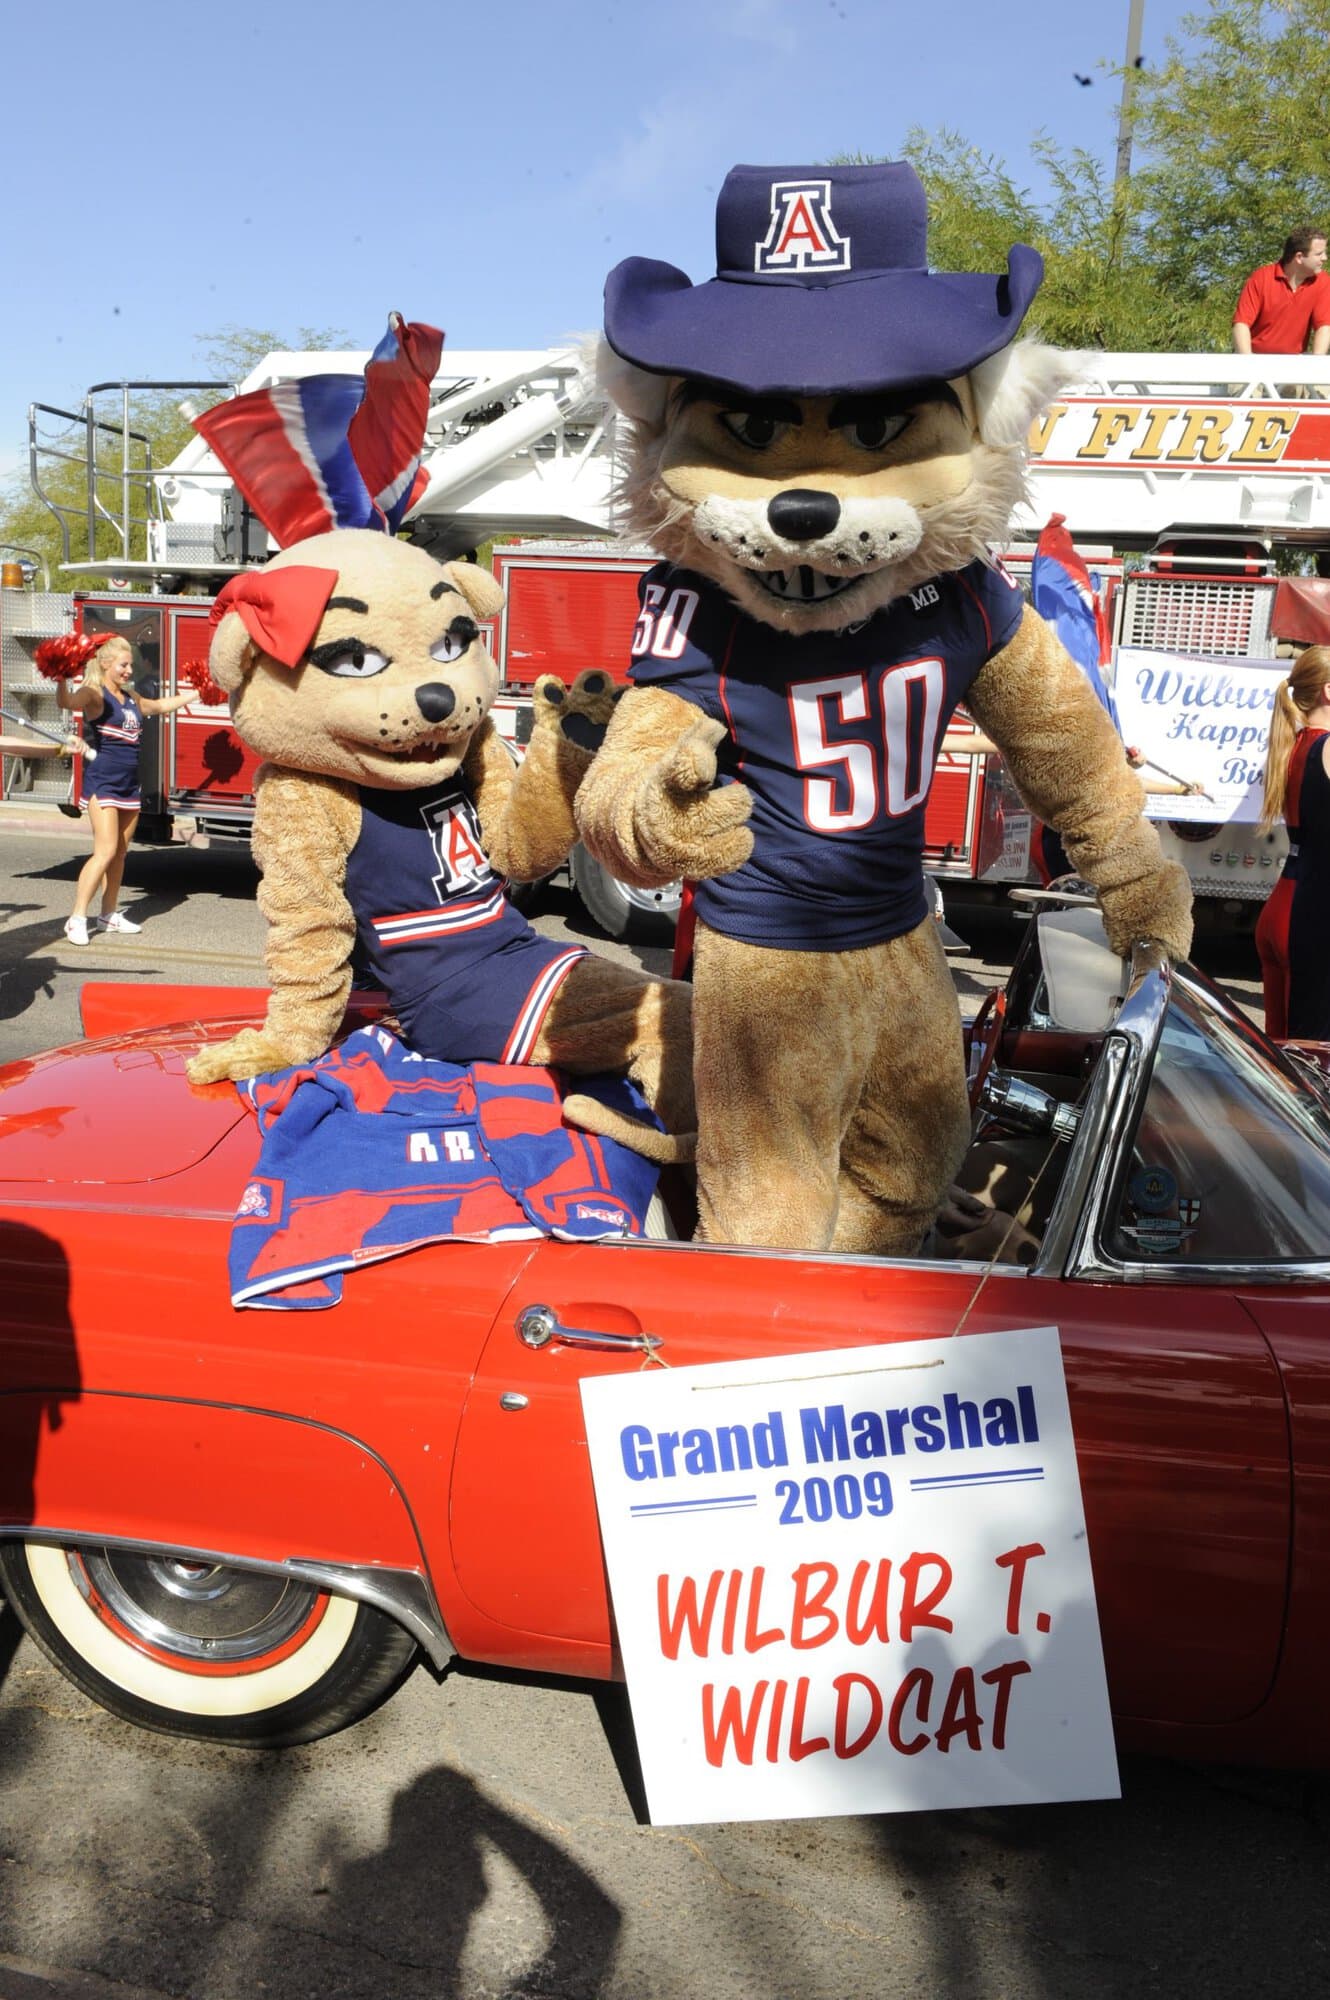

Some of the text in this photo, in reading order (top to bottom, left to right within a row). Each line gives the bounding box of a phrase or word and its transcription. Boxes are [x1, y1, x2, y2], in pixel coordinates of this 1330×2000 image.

[754, 180, 851, 273] A
[1077, 406, 1299, 463] FIRE
[631, 583, 700, 660] 50
[908, 583, 941, 612] MB
[787, 655, 947, 834] 50
[419, 791, 497, 905] A
[619, 1385, 1040, 1482] Grand Marshal
[774, 1471, 894, 1525] 2009
[656, 1542, 1052, 1661] WILBUR T.
[701, 1660, 1032, 1768] WILDCAT
